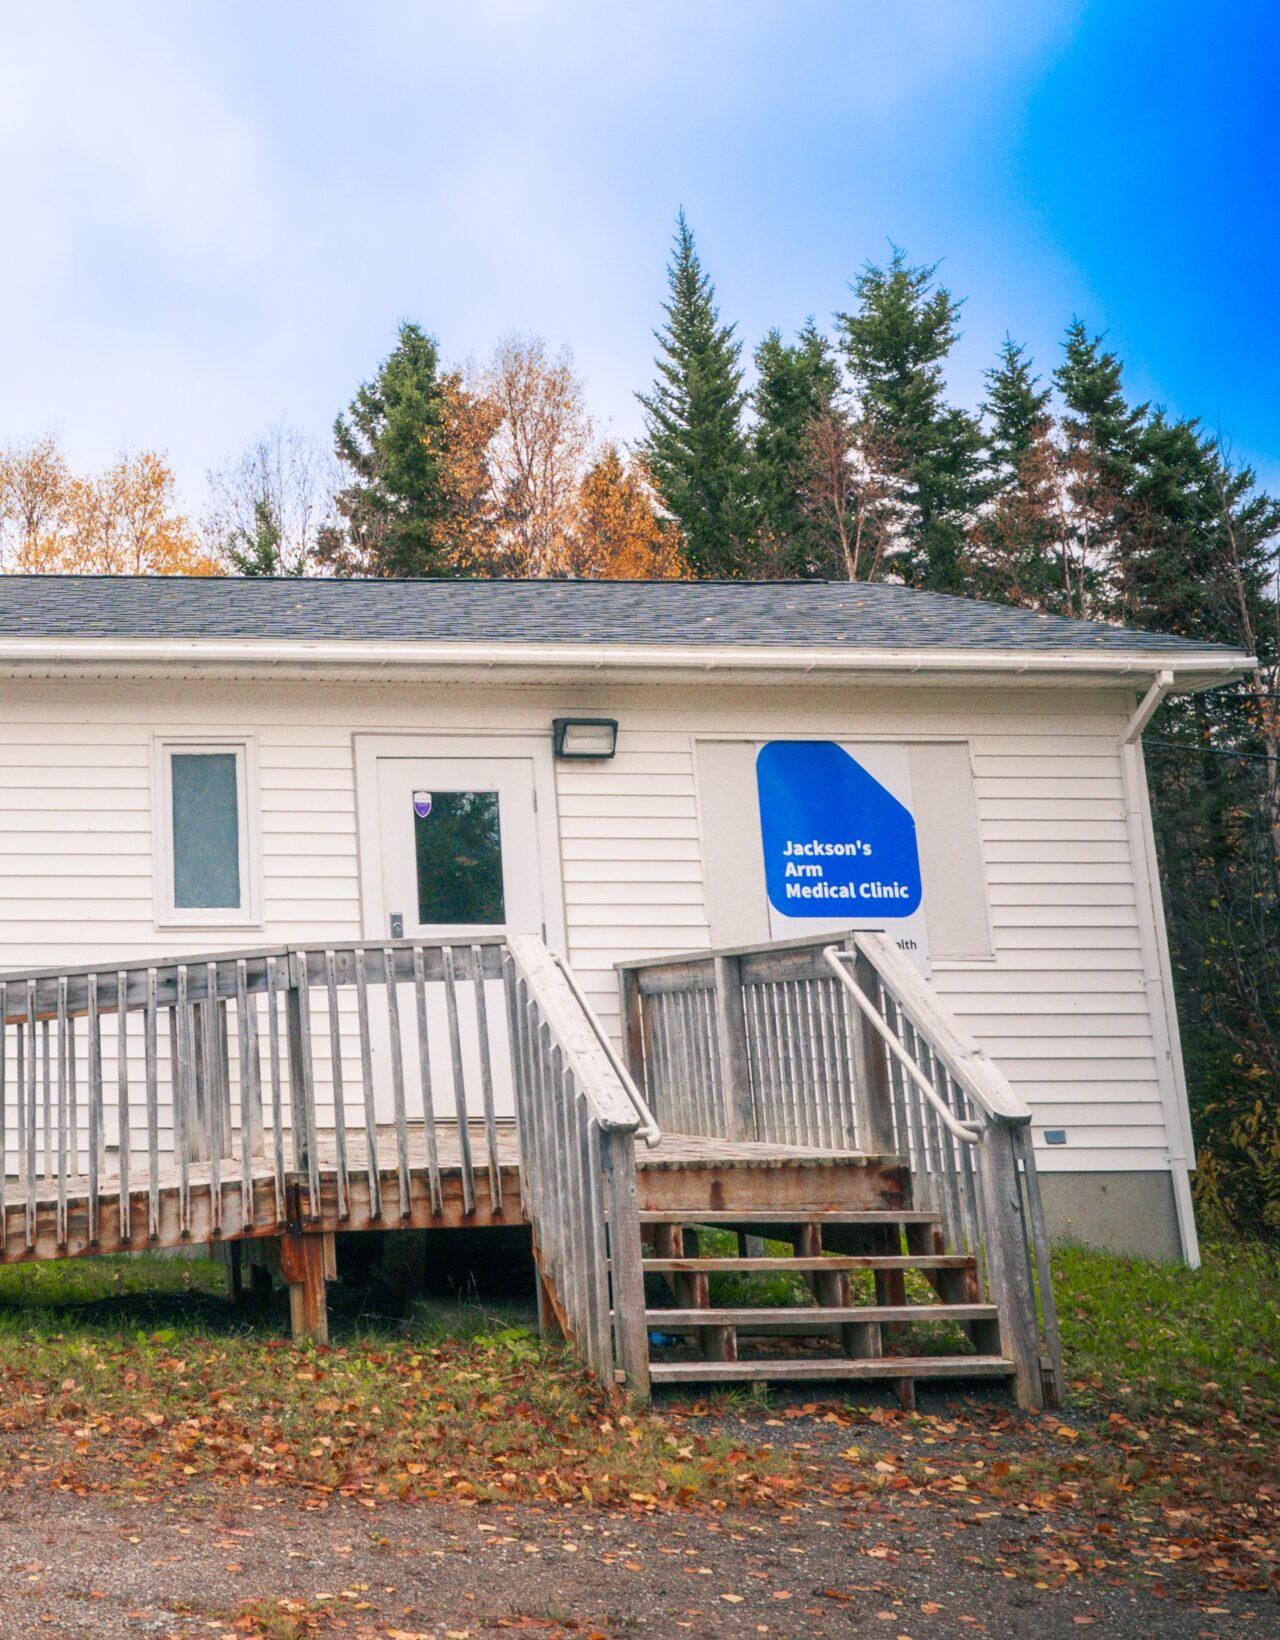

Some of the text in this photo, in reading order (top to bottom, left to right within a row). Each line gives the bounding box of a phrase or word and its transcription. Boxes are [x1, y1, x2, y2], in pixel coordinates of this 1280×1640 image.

[783, 840, 872, 856] Jackson's
[785, 862, 823, 877] Arm
[786, 882, 909, 898] Medical Clinic
